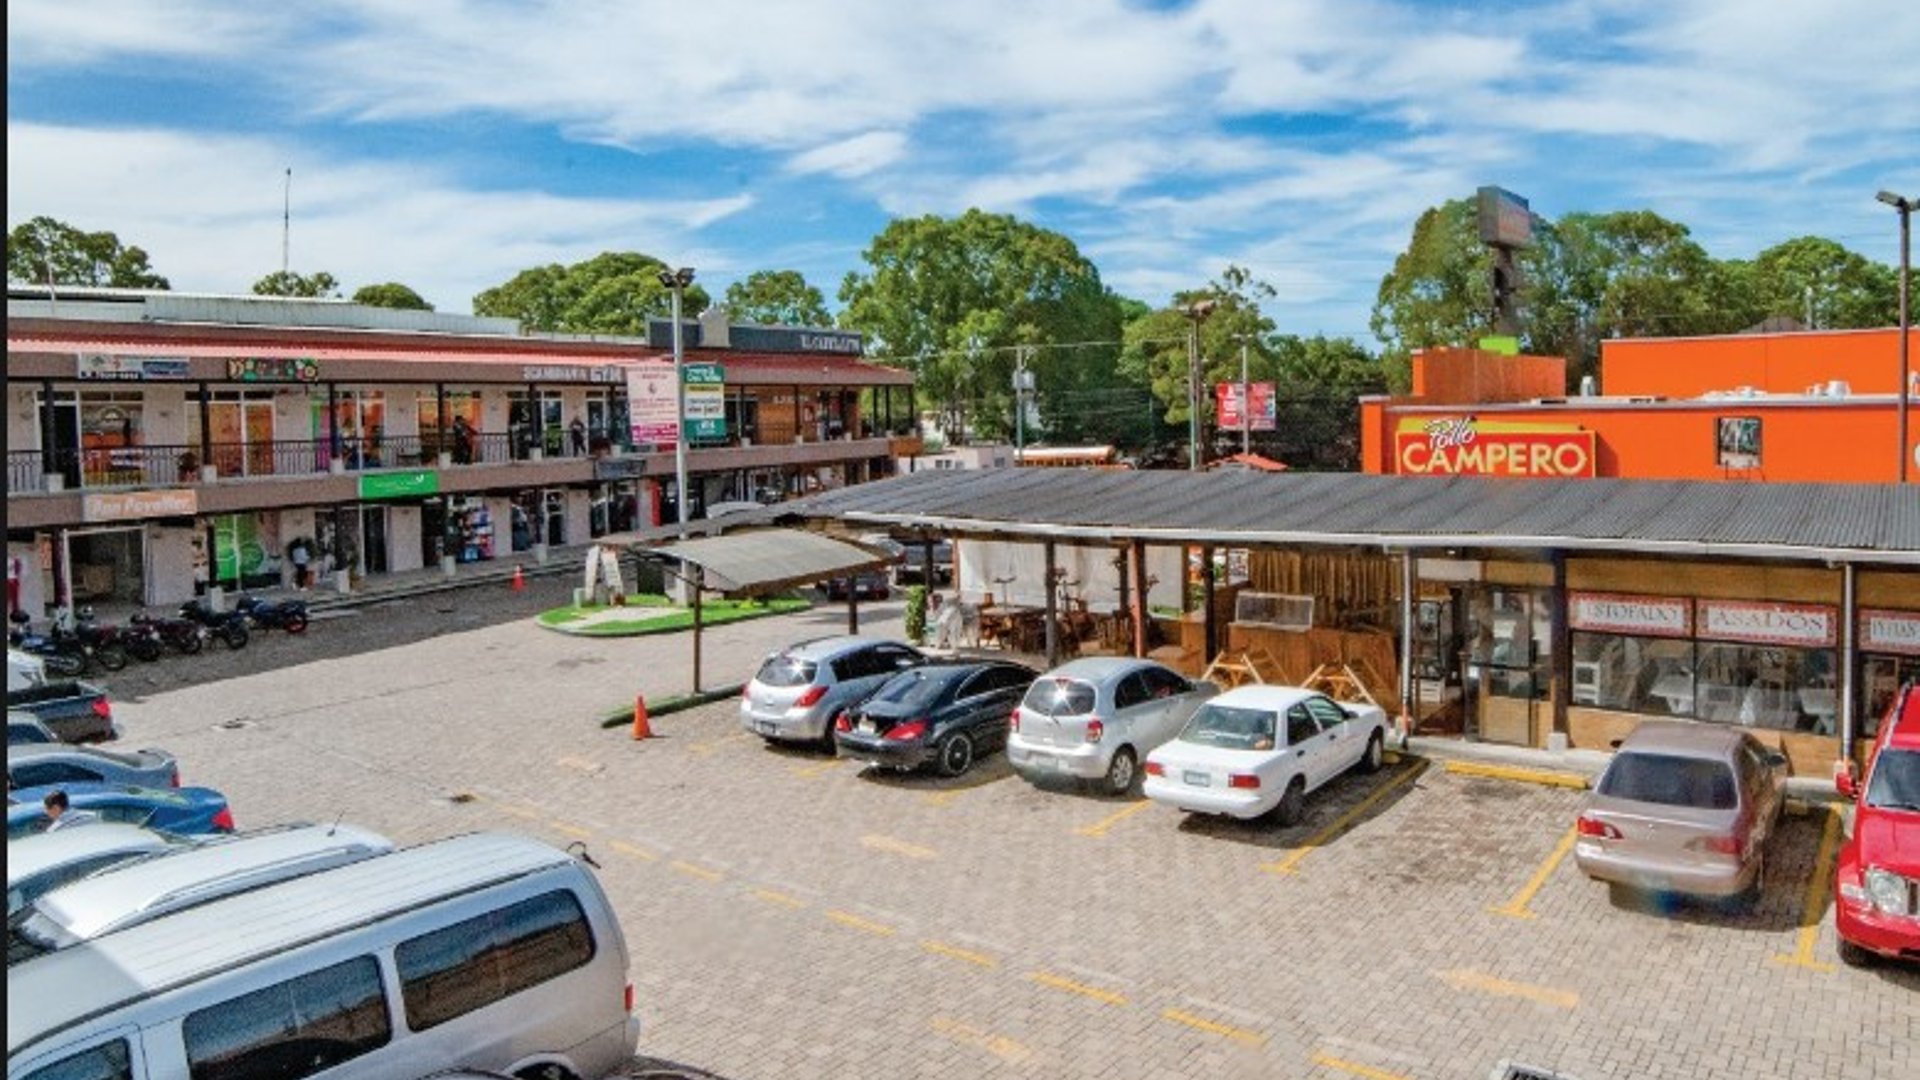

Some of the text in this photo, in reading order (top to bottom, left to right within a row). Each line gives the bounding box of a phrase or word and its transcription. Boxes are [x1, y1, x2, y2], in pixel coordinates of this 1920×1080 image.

[1424, 415, 1476, 450] Pollo
[1402, 442, 1587, 475] CAMPERO
[1712, 609, 1823, 631] ASADOS
